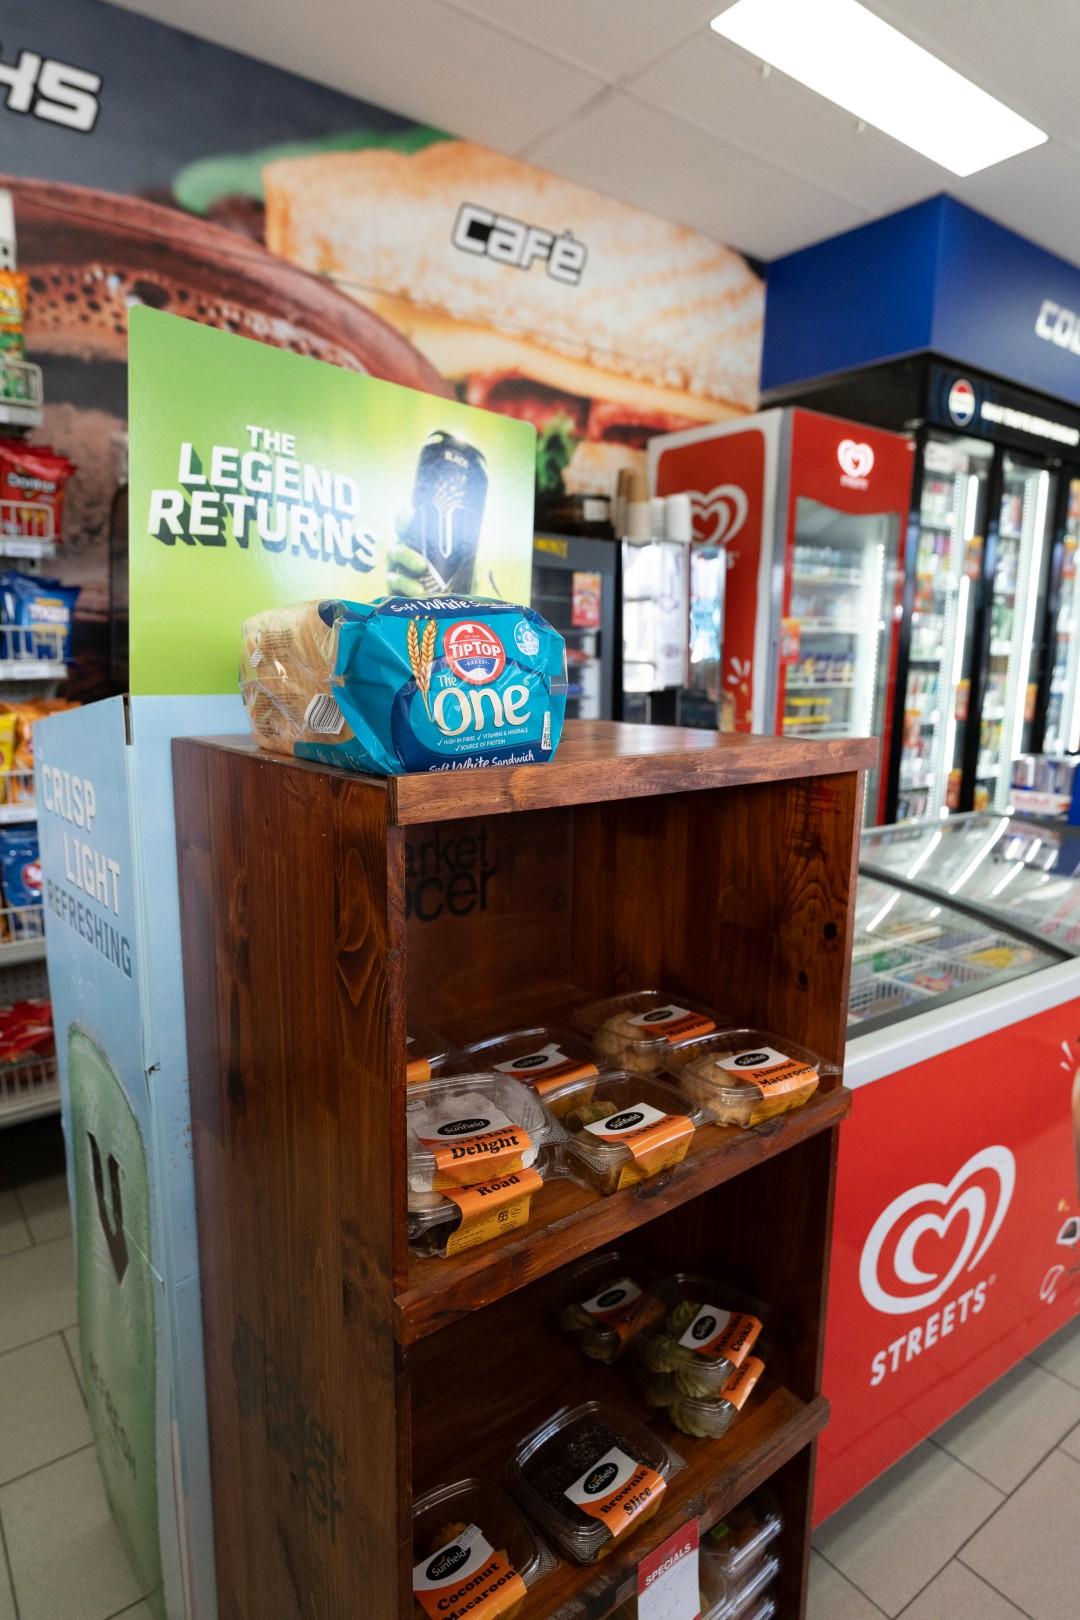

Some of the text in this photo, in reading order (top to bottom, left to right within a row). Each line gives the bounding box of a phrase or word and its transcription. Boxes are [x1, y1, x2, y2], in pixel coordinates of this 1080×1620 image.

[246, 424, 297, 456] THE
[178, 442, 362, 518] LEGEND
[147, 489, 379, 570] RETURNS
[420, 599, 471, 611] White
[436, 674, 458, 687] The
[491, 750, 535, 767] Sandwich
[41, 763, 97, 833] CRISP
[63, 831, 121, 916] LIGHT
[46, 876, 133, 979] REFRESHING
[444, 1120, 486, 1134] Sunfield
[450, 1134, 520, 1160] Delight
[476, 1174, 521, 1197] Road
[869, 1280, 988, 1387] STREETS
[600, 1469, 649, 1514] Brownie
[623, 1486, 653, 1516] Slice
[431, 1549, 468, 1578] Sunfield
[645, 1542, 692, 1586] SPECIALS
[437, 1561, 500, 1612] Coconut
